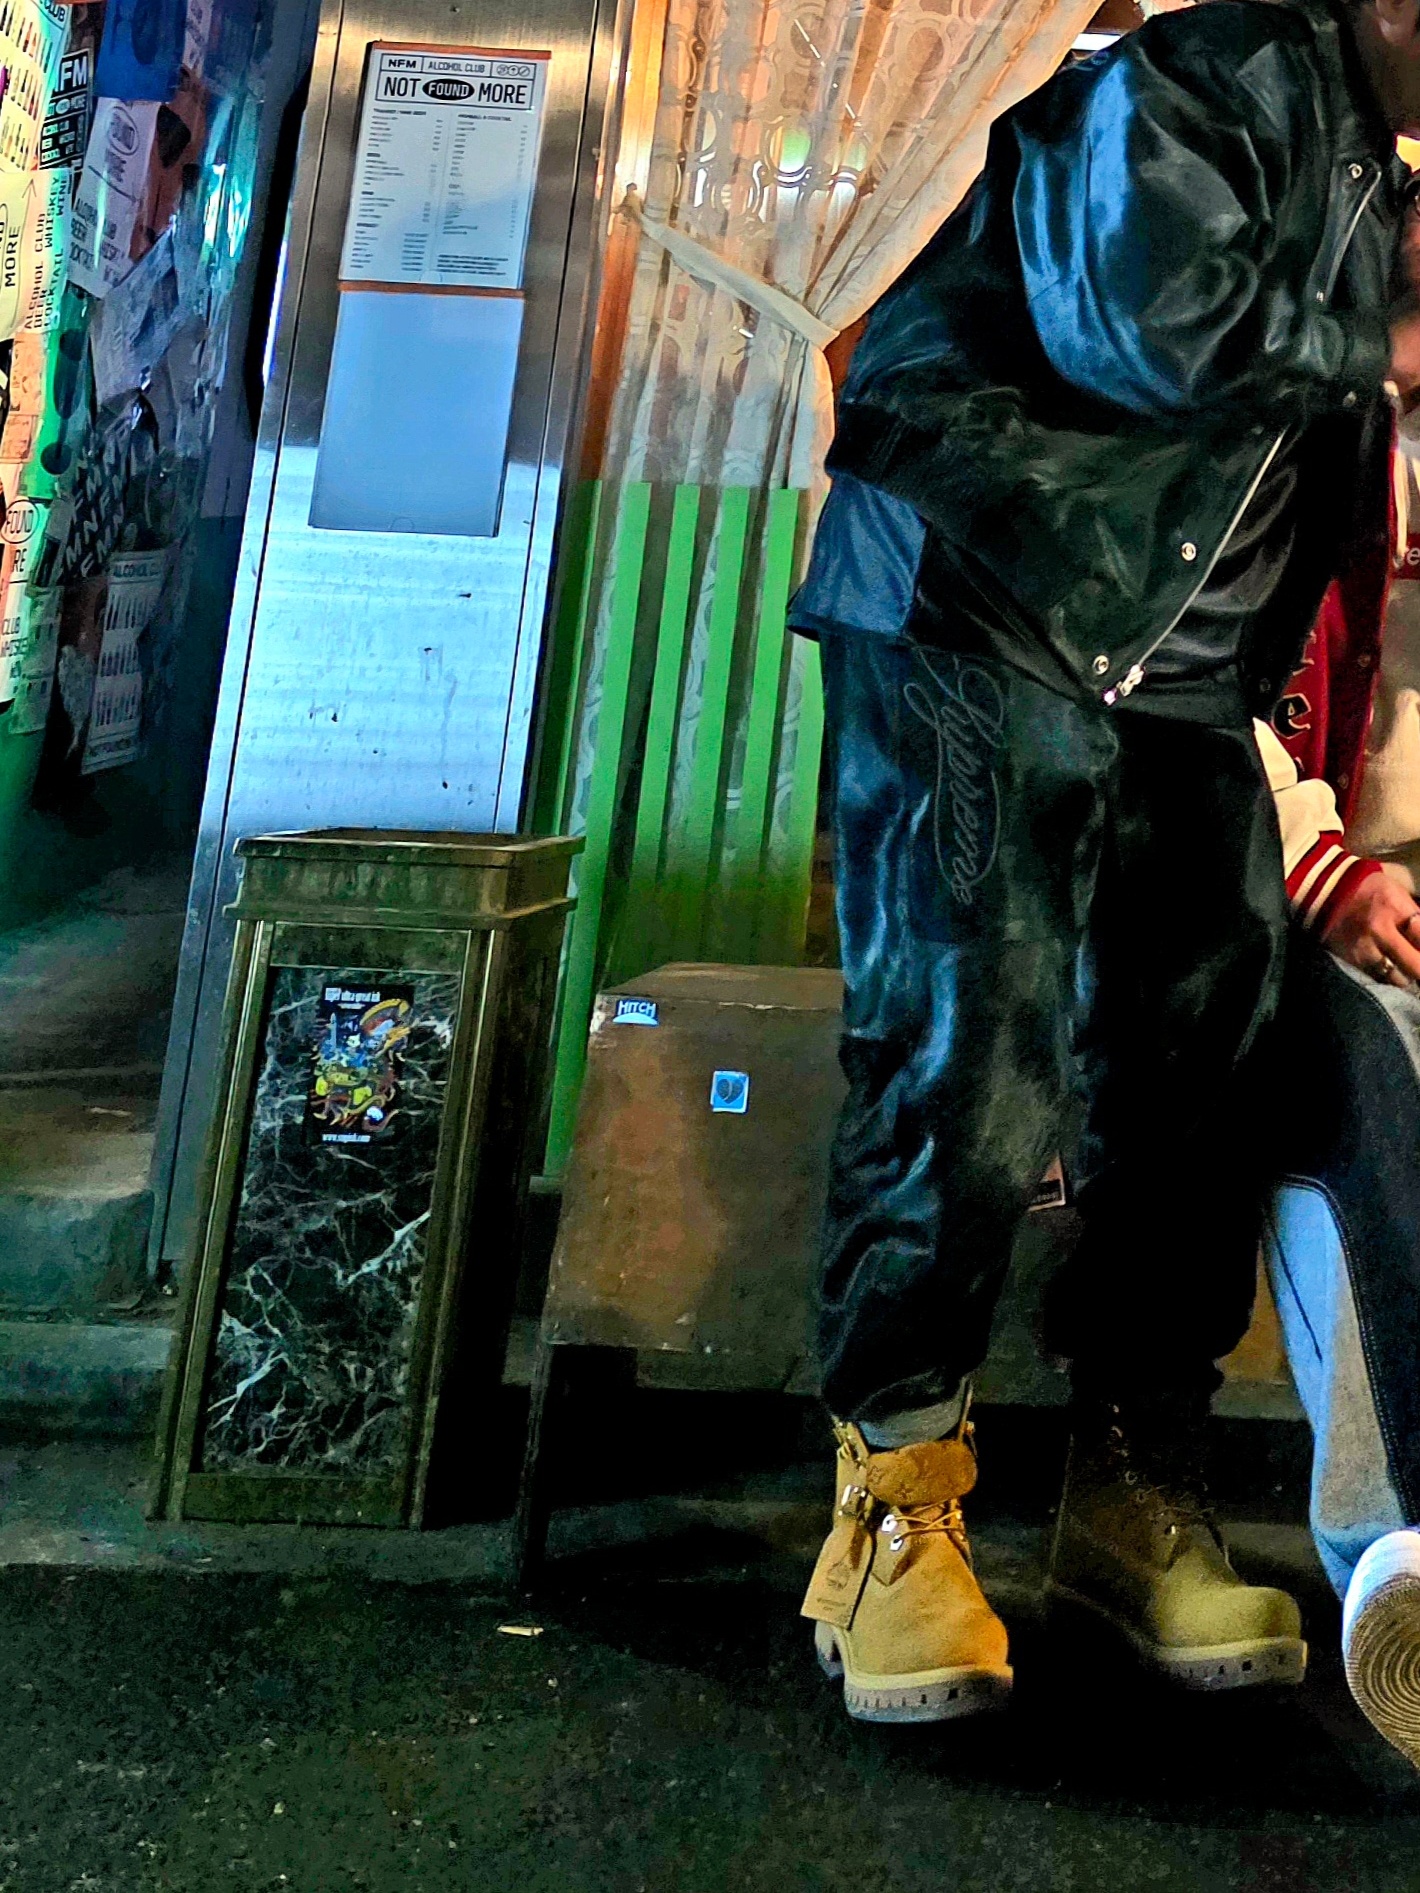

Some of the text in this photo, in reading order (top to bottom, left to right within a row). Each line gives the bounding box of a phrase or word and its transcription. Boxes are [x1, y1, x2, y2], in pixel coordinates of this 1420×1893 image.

[55, 56, 87, 92] FM
[388, 59, 486, 74] NFM ALCOHOL CLUB
[384, 77, 527, 105] NOT FOUND MORE
[44, 176, 60, 248] WHISKEY
[4, 225, 21, 287] MORE
[25, 260, 45, 330] ALCOHOL
[44, 247, 64, 328] COCKTAIL
[4, 509, 33, 535] FOUND
[618, 999, 657, 1018] HITCH
